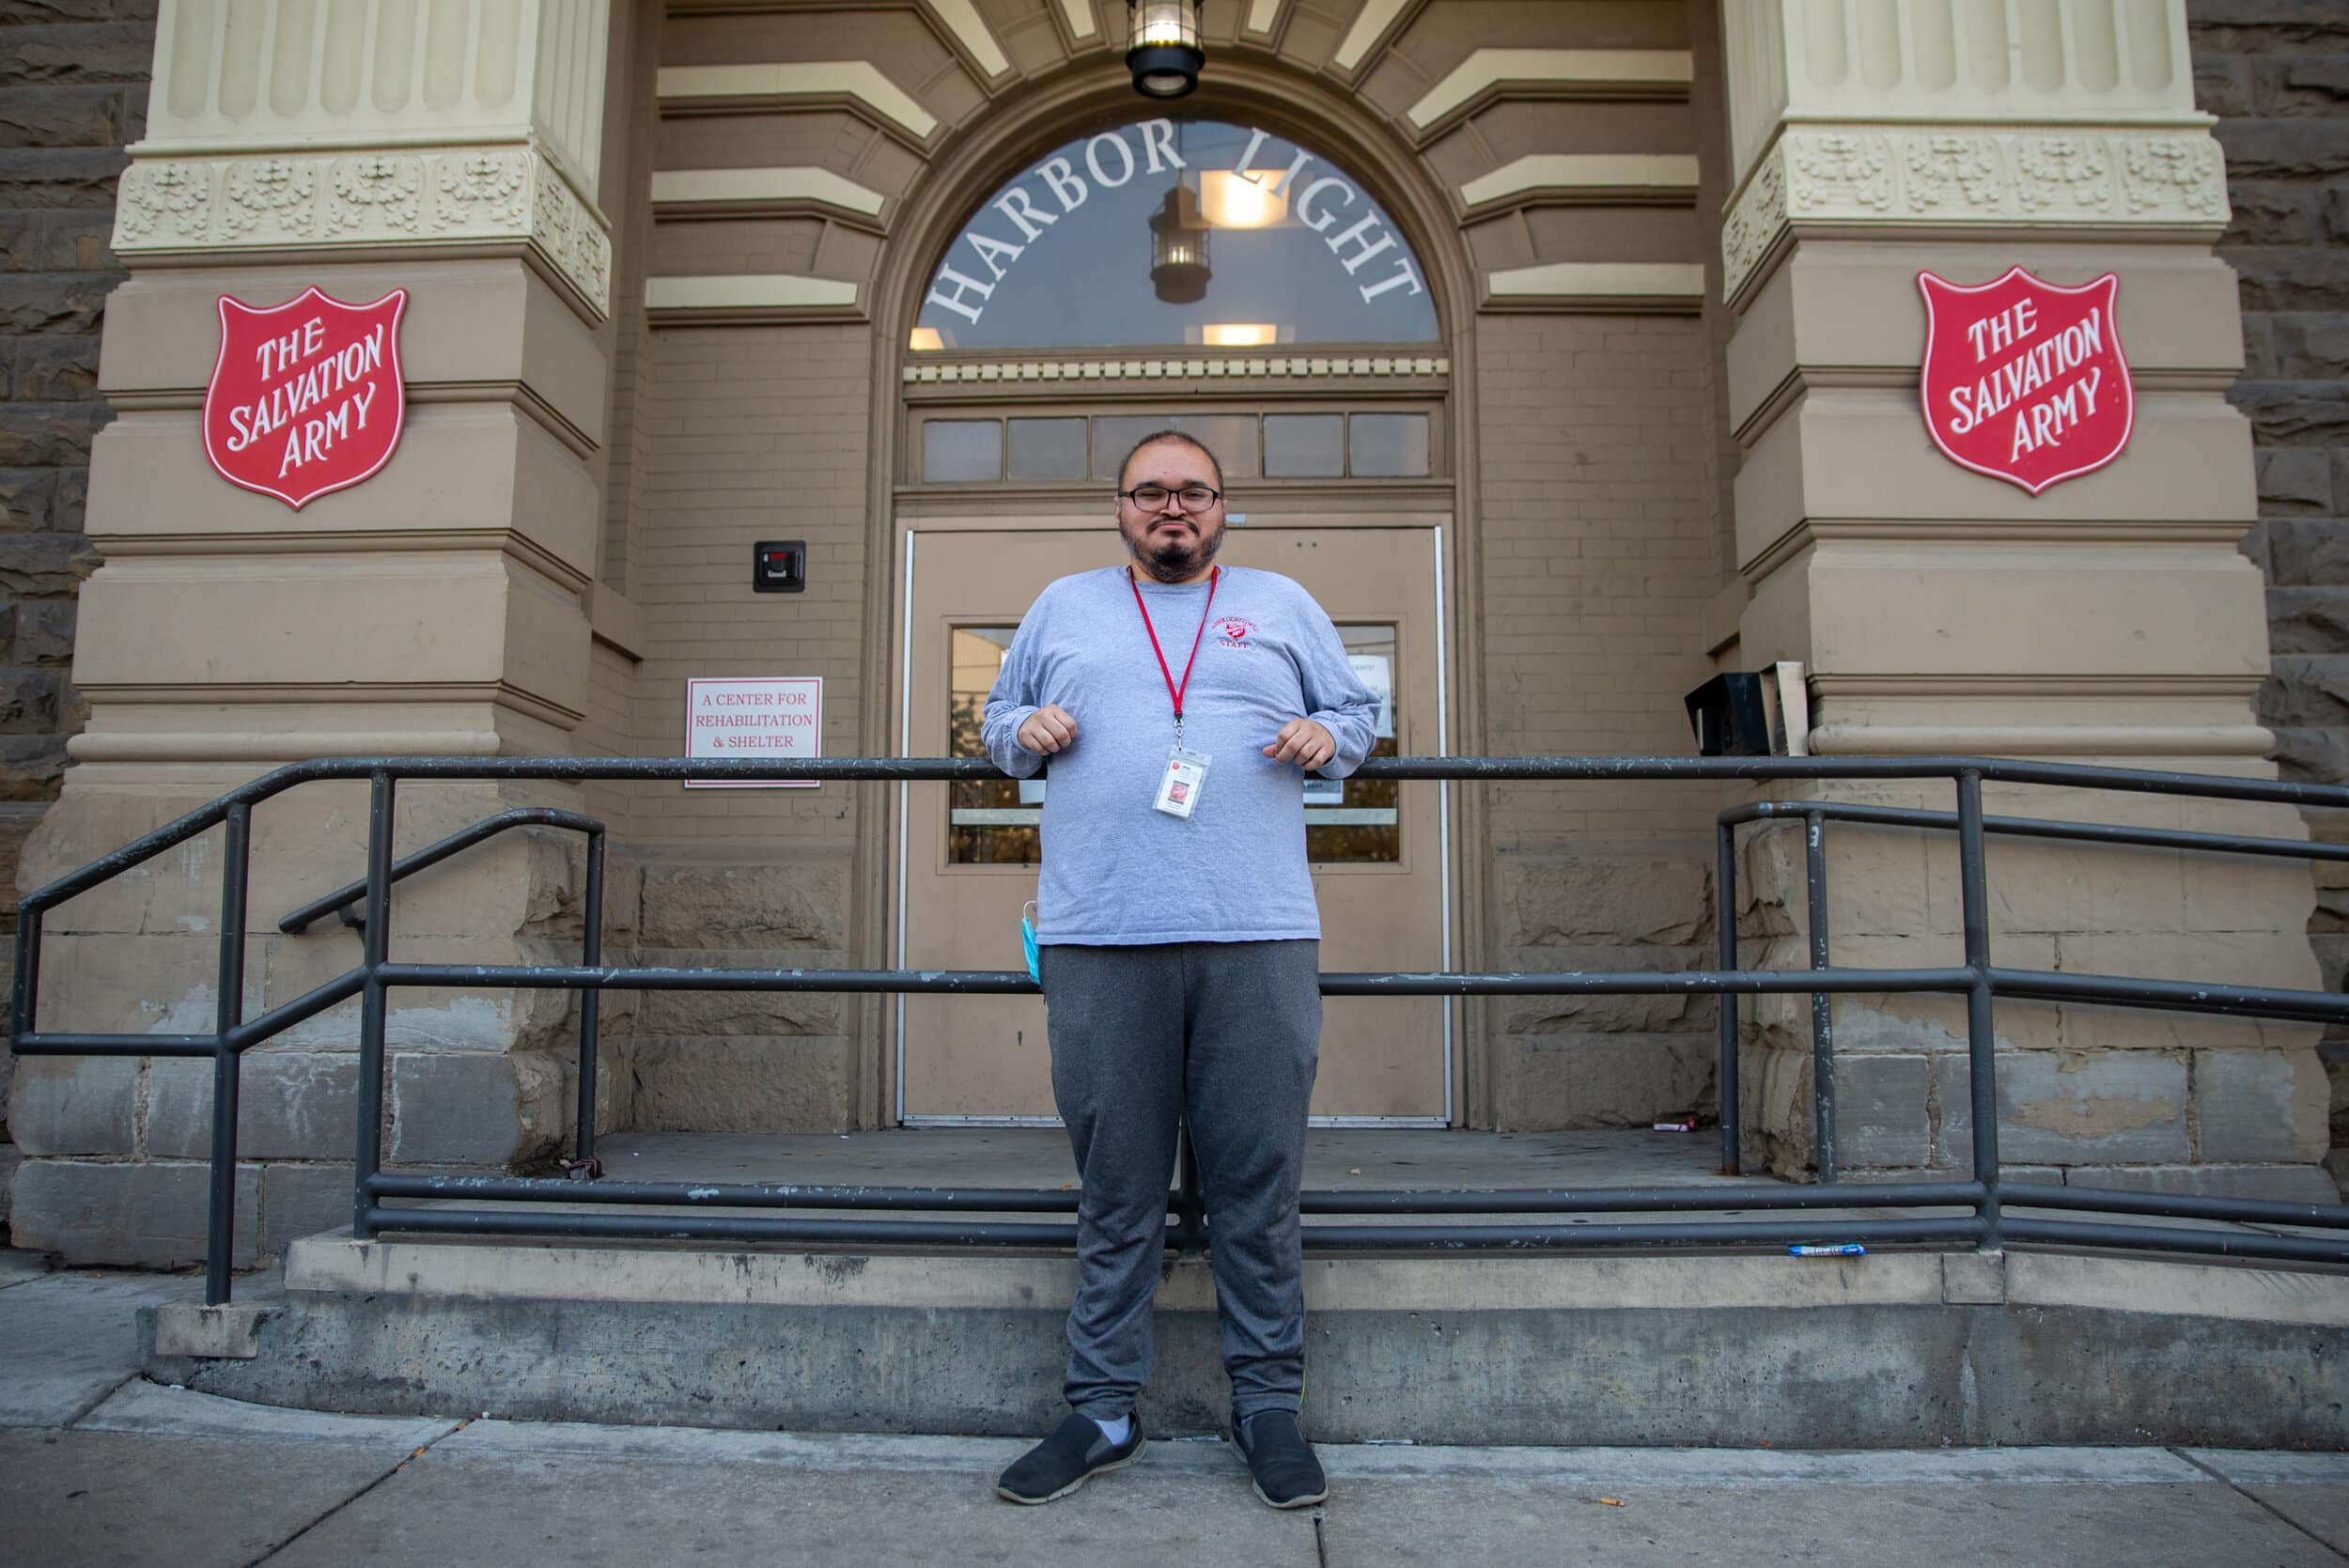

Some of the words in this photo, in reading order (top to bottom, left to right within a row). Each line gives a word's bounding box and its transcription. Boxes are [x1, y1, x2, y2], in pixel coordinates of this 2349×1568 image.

[926, 117, 1187, 325] HARBOR
[1231, 127, 1423, 305] LIGHT
[256, 316, 325, 381] THE
[1968, 297, 2038, 363] THE
[226, 323, 383, 452] SALVATION
[1949, 306, 2103, 434] SALVATION
[278, 381, 376, 479] ARMY
[2010, 366, 2101, 464] ARMY
[1220, 639, 1248, 648] STAFF
[695, 714, 813, 727] REHABILITATION
[702, 693, 712, 706] A
[716, 693, 773, 706] CENTER
[778, 692, 807, 706] FOR
[713, 736, 724, 748] &
[728, 736, 794, 748] SHELTER
